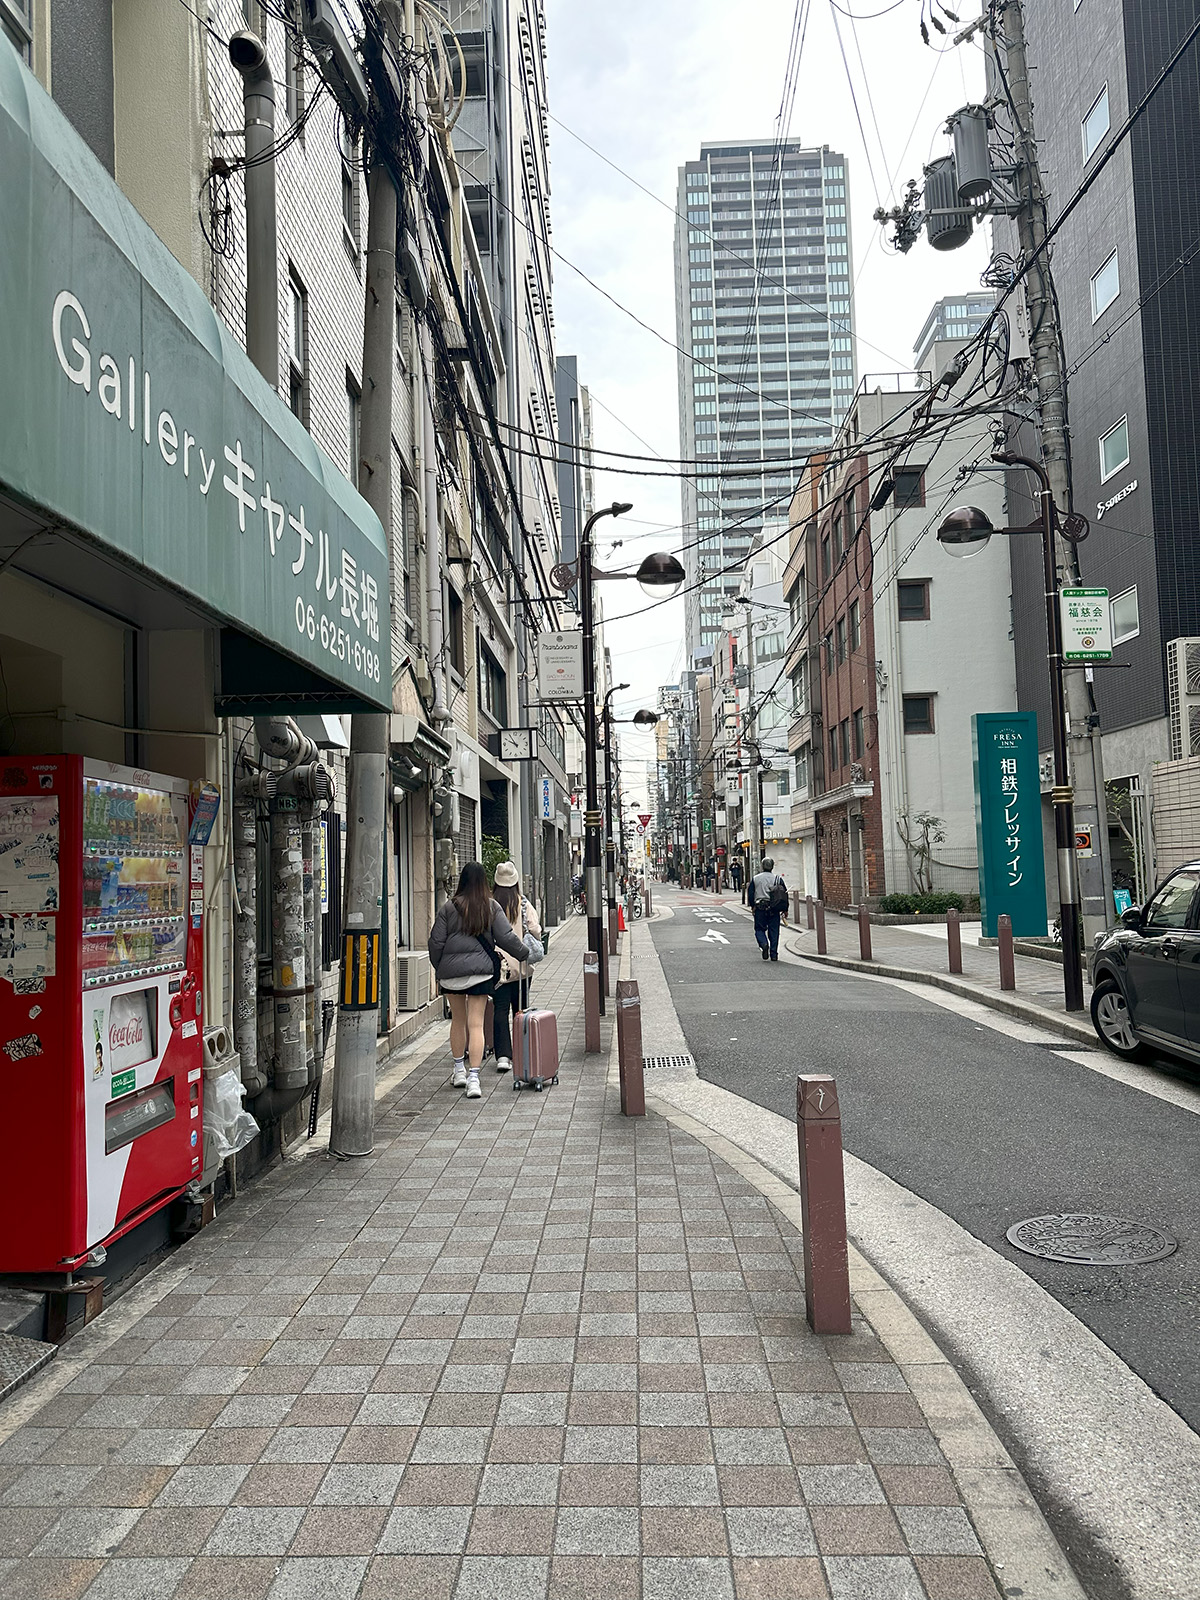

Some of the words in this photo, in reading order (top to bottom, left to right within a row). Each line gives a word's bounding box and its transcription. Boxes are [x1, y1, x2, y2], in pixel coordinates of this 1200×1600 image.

[53, 290, 216, 494] Gallery
[993, 733, 1023, 741] FRESA
[542, 779, 550, 818] SANSHIN
[1000, 757, 1023, 887] 相鉄フレッサイン
